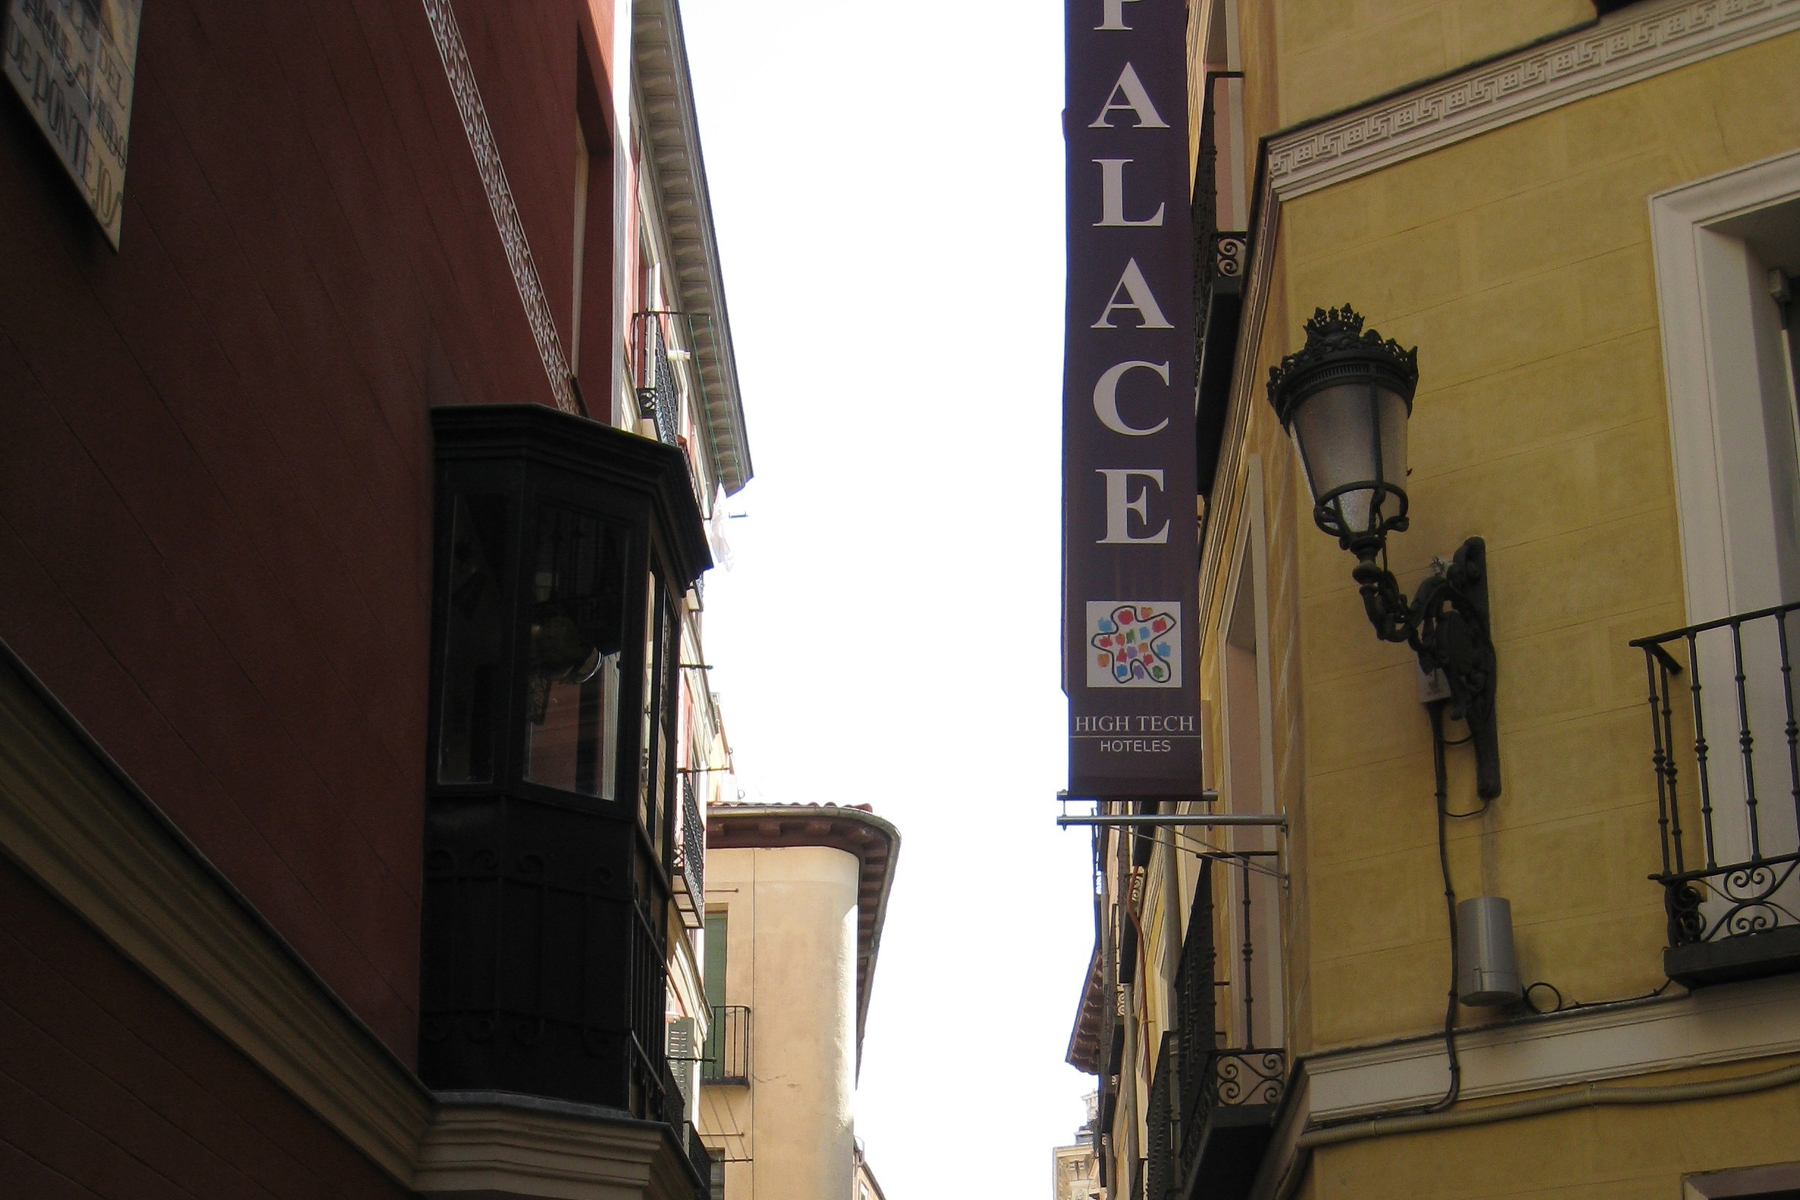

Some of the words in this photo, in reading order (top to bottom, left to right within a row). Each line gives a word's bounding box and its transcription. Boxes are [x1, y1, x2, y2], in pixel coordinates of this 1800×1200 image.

[31, 50, 123, 229] PONTEJOS
[1075, 715, 1132, 733] HIGH
[1136, 715, 1194, 732] TECH
[1100, 739, 1171, 753] HOTELES
